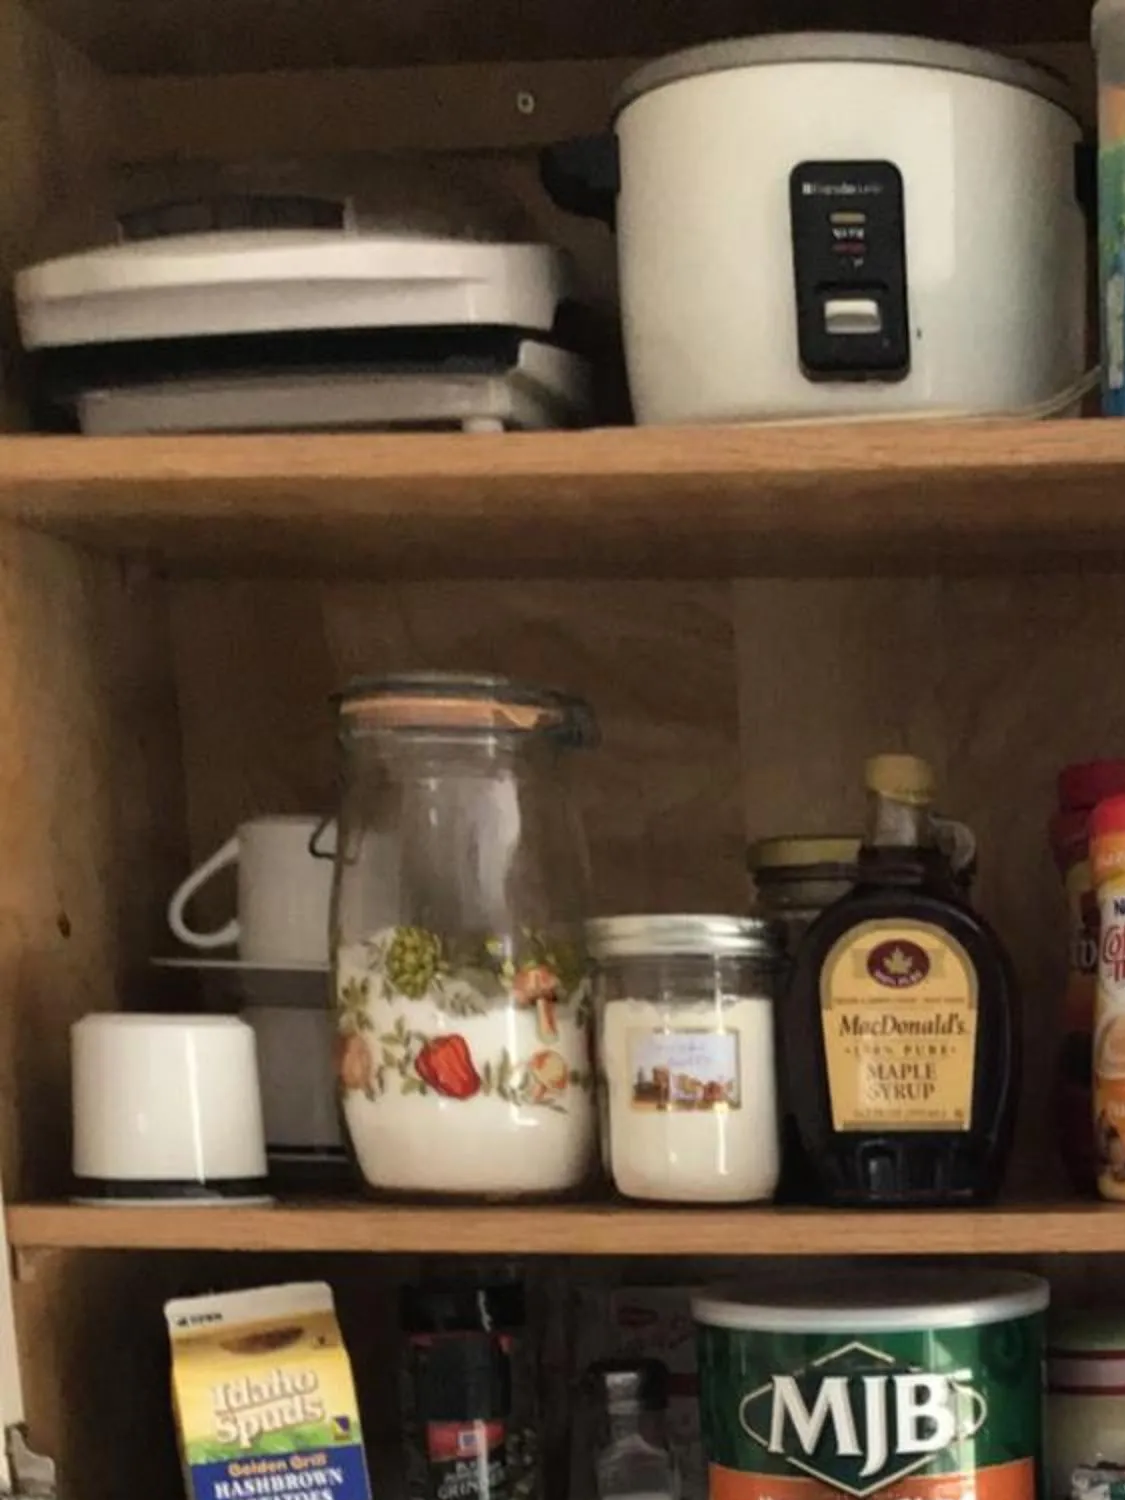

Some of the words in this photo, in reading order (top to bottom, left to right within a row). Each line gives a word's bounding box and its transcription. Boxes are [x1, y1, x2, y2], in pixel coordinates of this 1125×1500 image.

[839, 1012, 966, 1036] MacDonald's
[866, 1062, 937, 1081] MAPLE
[867, 1082, 935, 1101] SYRUP
[212, 1368, 319, 1411] Idaho
[216, 1398, 325, 1448] Spuds
[768, 1373, 955, 1477] MJB
[228, 1457, 288, 1477] Golden
[214, 1467, 344, 1500] HASHBROWN
